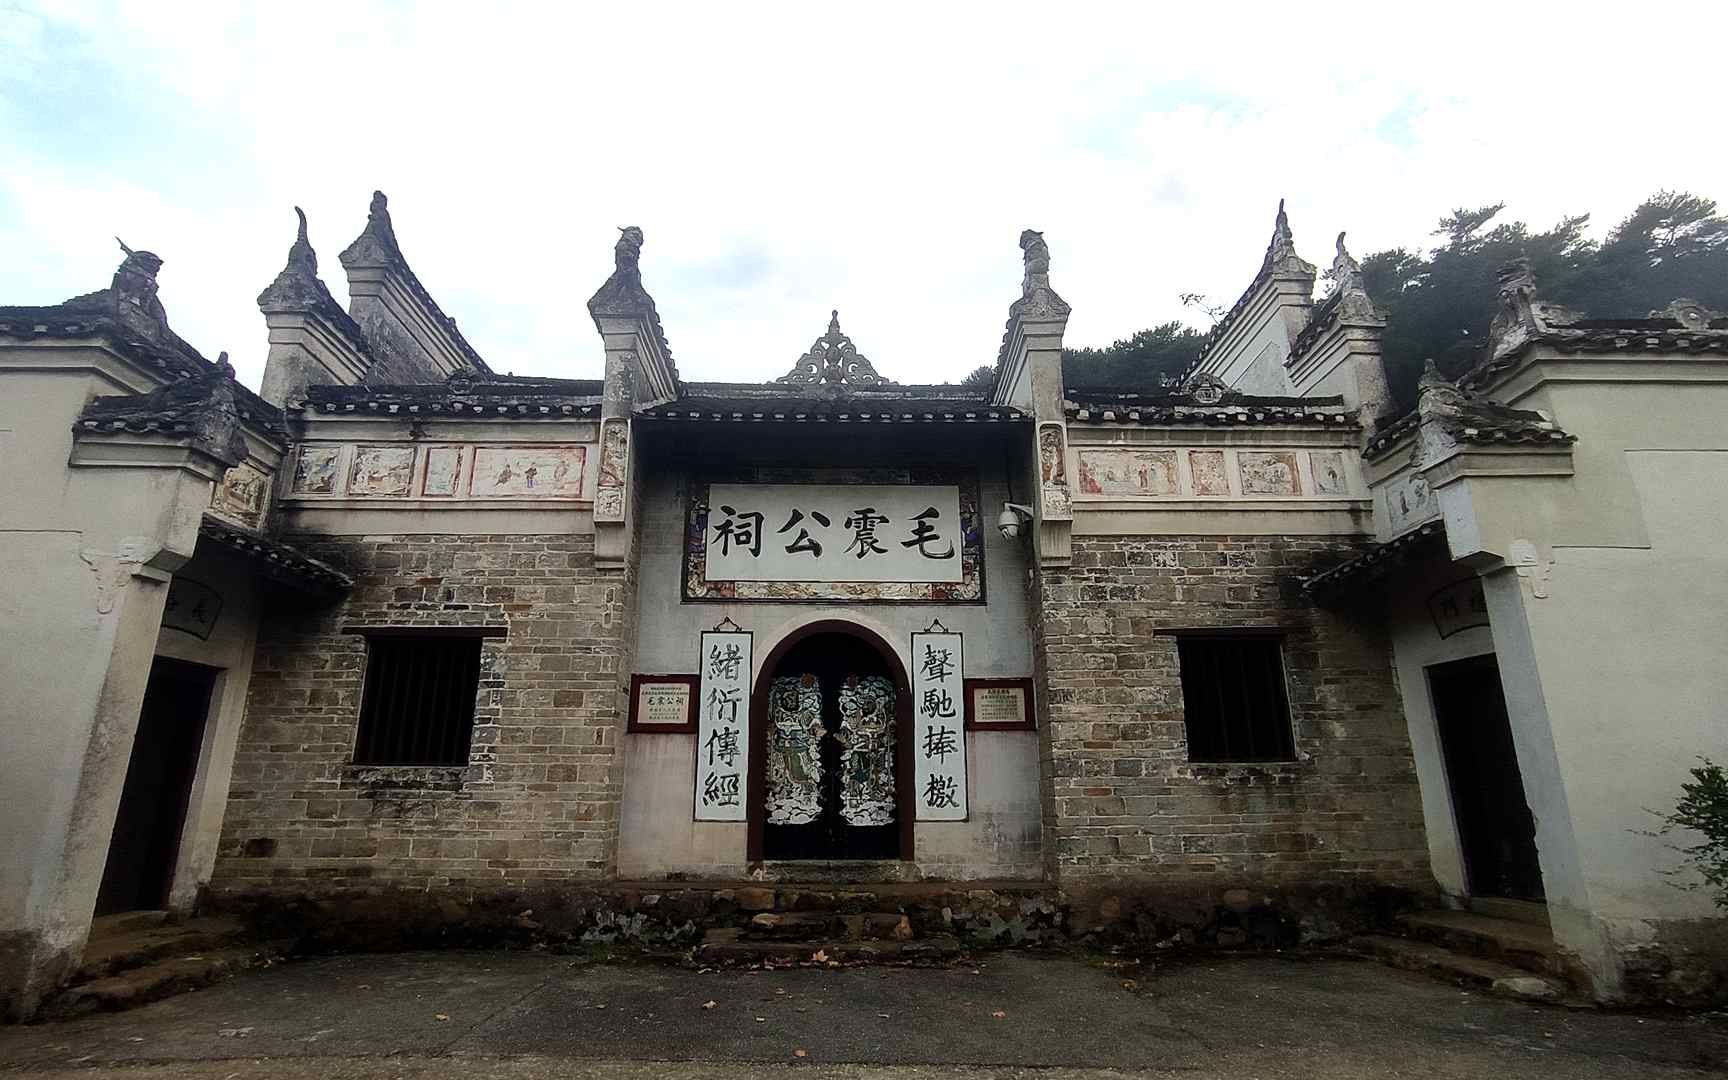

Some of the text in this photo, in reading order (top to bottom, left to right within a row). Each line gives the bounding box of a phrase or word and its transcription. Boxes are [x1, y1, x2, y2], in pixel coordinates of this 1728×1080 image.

[711, 506, 955, 560] 毛震公祠
[702, 644, 744, 808] 緒衍傳經
[920, 644, 960, 809] 聲馳捧檄
